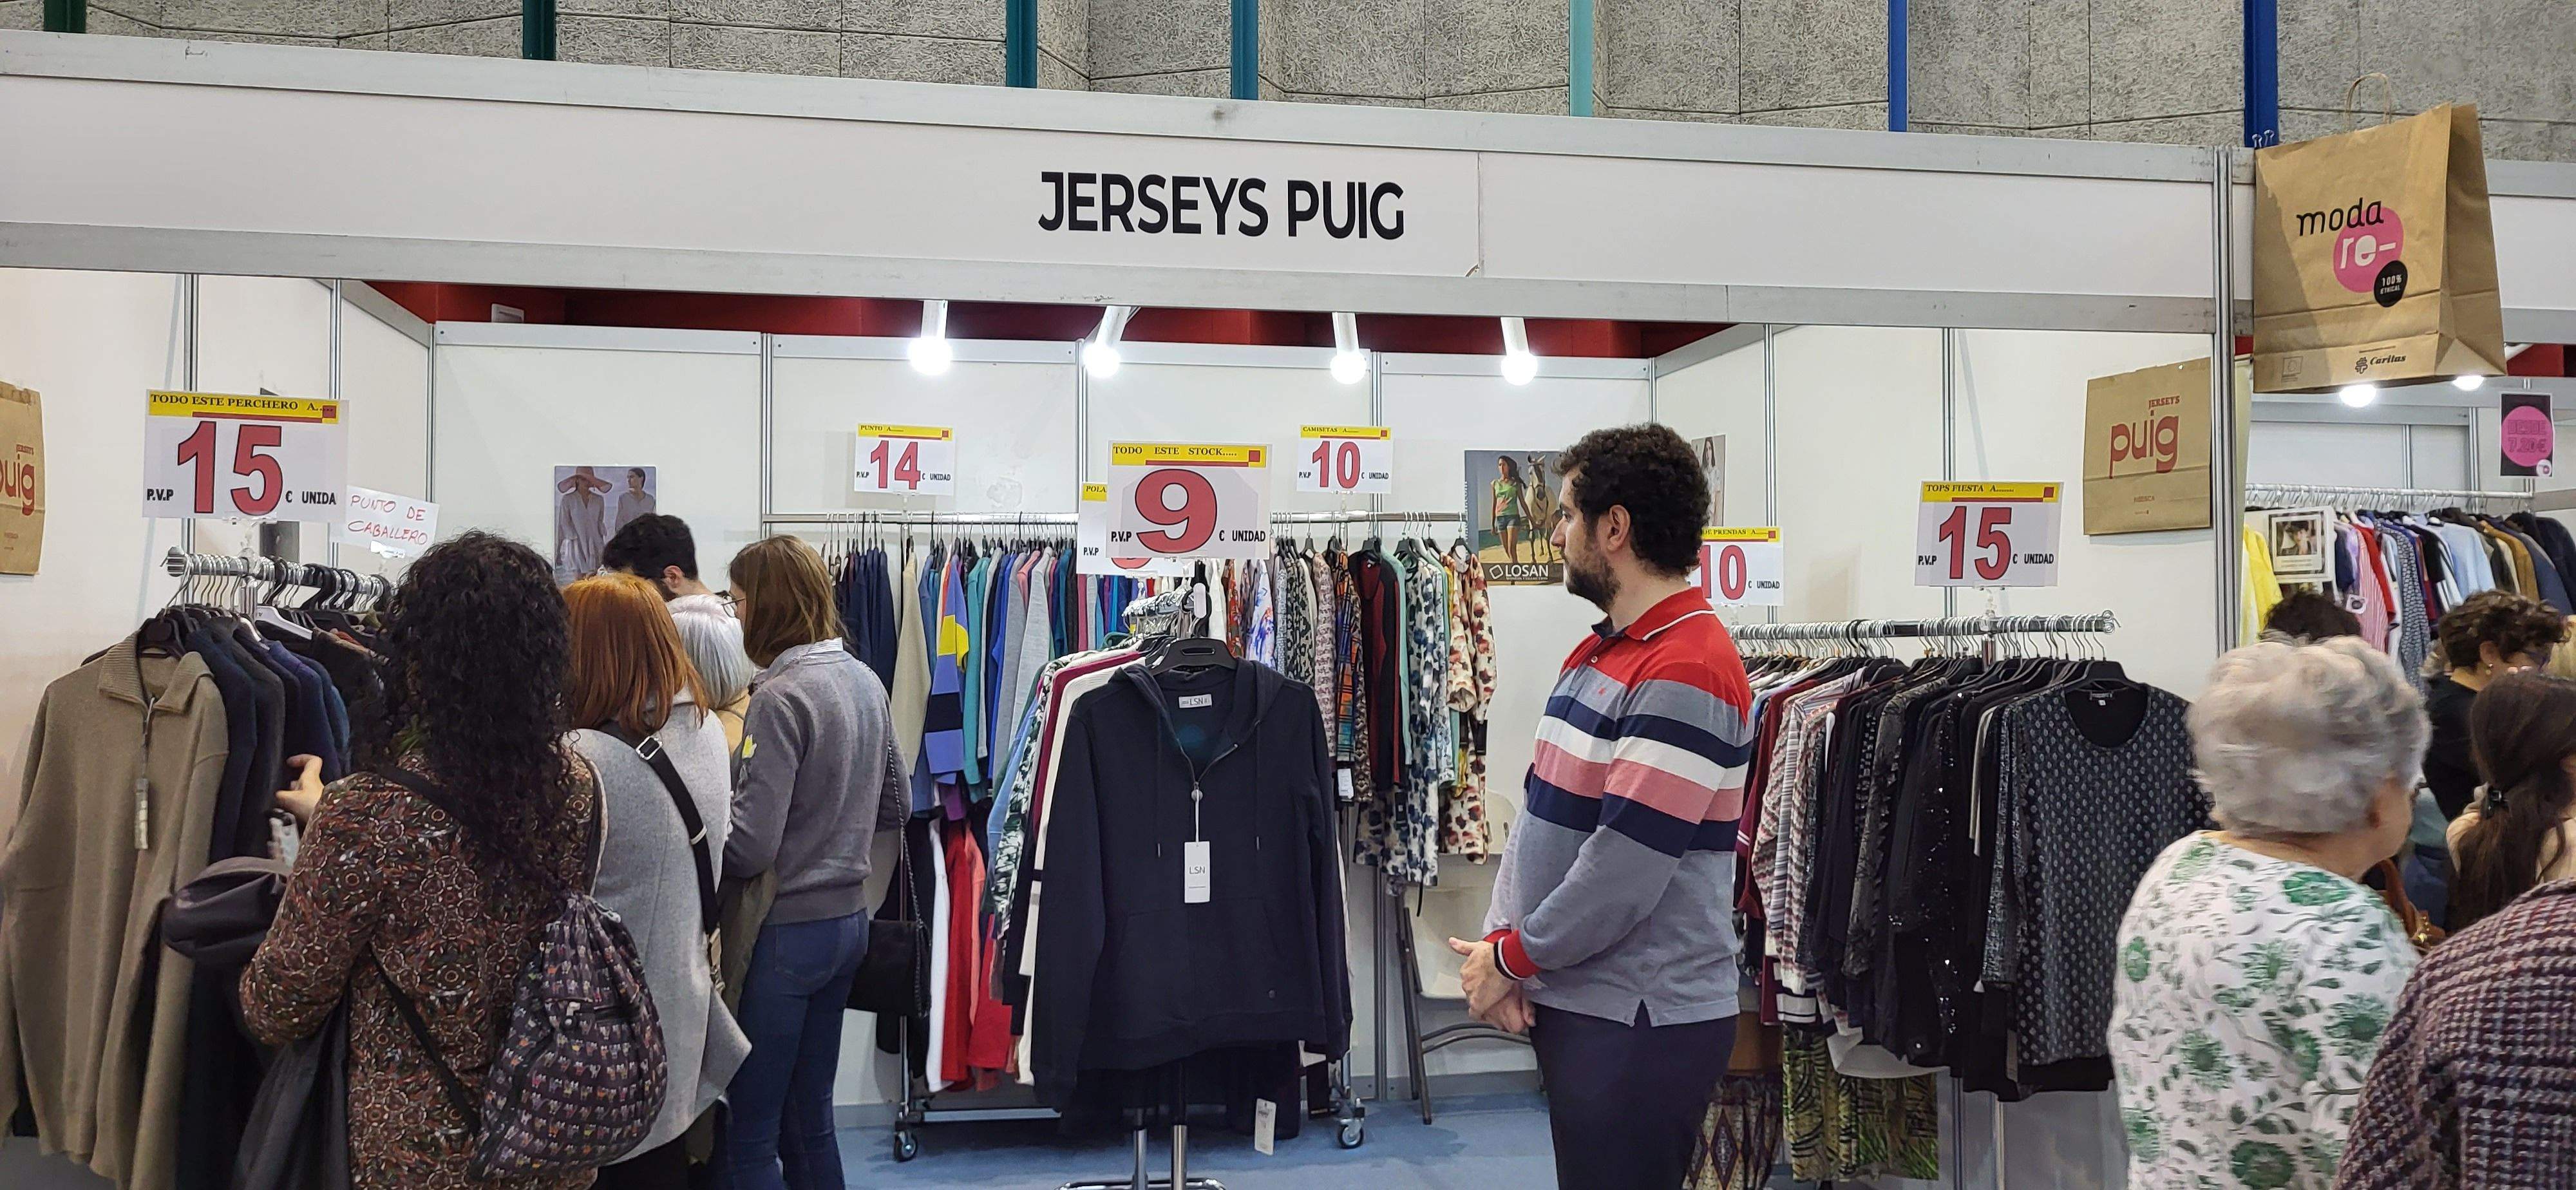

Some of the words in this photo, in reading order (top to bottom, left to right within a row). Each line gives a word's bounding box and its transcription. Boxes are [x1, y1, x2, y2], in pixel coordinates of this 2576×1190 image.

[1038, 171, 1269, 237] JERSEYS
[1288, 180, 1404, 240] PUIG
[2297, 197, 2384, 236] moda
[2340, 235, 2396, 269] re-
[2382, 274, 2401, 286] 100%
[2380, 285, 2400, 294] ETHICAL
[151, 394, 188, 404] TODO
[193, 397, 224, 406] ESTE
[228, 399, 298, 410] PERCHERO
[2148, 395, 2180, 409] JERSEYS
[1113, 446, 1142, 455] TODO
[2109, 410, 2179, 479] puig
[178, 421, 283, 516] 15
[871, 440, 921, 489] 14
[1312, 440, 1360, 489] 10
[0, 454, 34, 516] uig
[147, 489, 174, 501] P.V.P
[302, 491, 336, 505] UNIDA
[350, 495, 397, 513] PUNTO
[407, 506, 426, 521] DE
[1135, 468, 1217, 553] 9
[348, 520, 428, 545] CABALLERO
[1111, 531, 1132, 542] P.V.P
[1232, 530, 1265, 542] UNIDAD
[1939, 505, 2012, 580] 15
[1083, 547, 1099, 556] P.V.P
[2024, 554, 2054, 564] UNIDAD
[1918, 555, 1937, 565] P.V.P
[1506, 564, 1548, 577] LOSAN
[1698, 545, 1747, 600] 10
[1189, 697, 1203, 706] LSN
[1189, 866, 1205, 874] LSN
